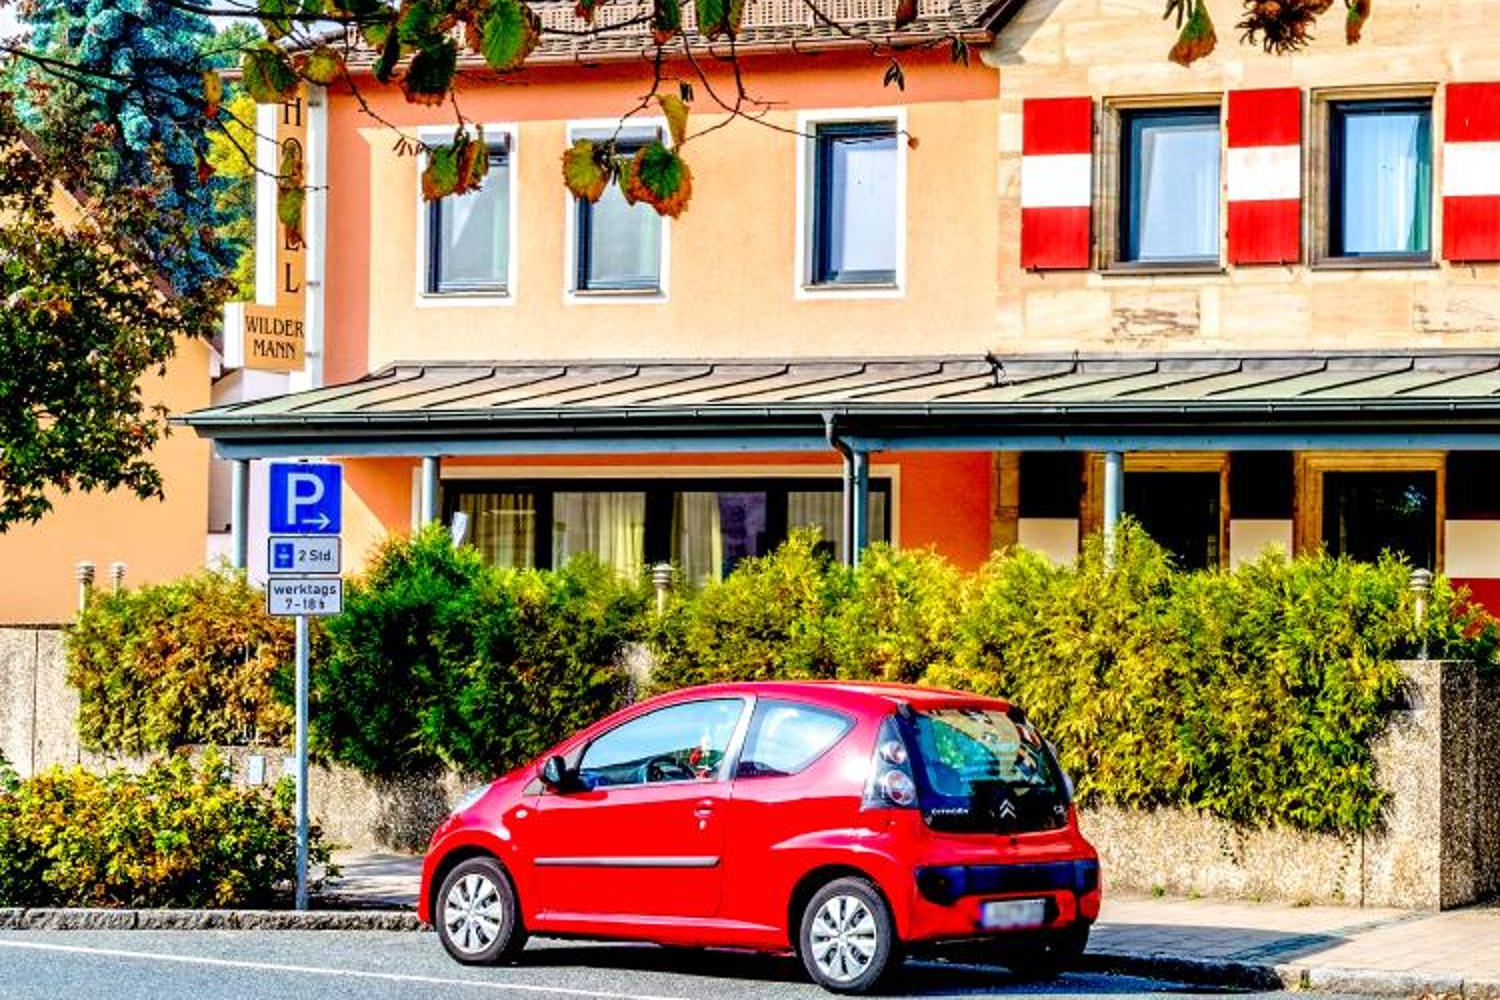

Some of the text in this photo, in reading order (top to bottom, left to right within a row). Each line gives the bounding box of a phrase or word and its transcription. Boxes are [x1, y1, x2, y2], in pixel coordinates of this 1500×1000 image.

[281, 96, 303, 293] HOL
[245, 315, 304, 339] WILDER
[253, 339, 297, 360] MANN
[287, 473, 325, 525] P
[274, 584, 337, 598] werktags
